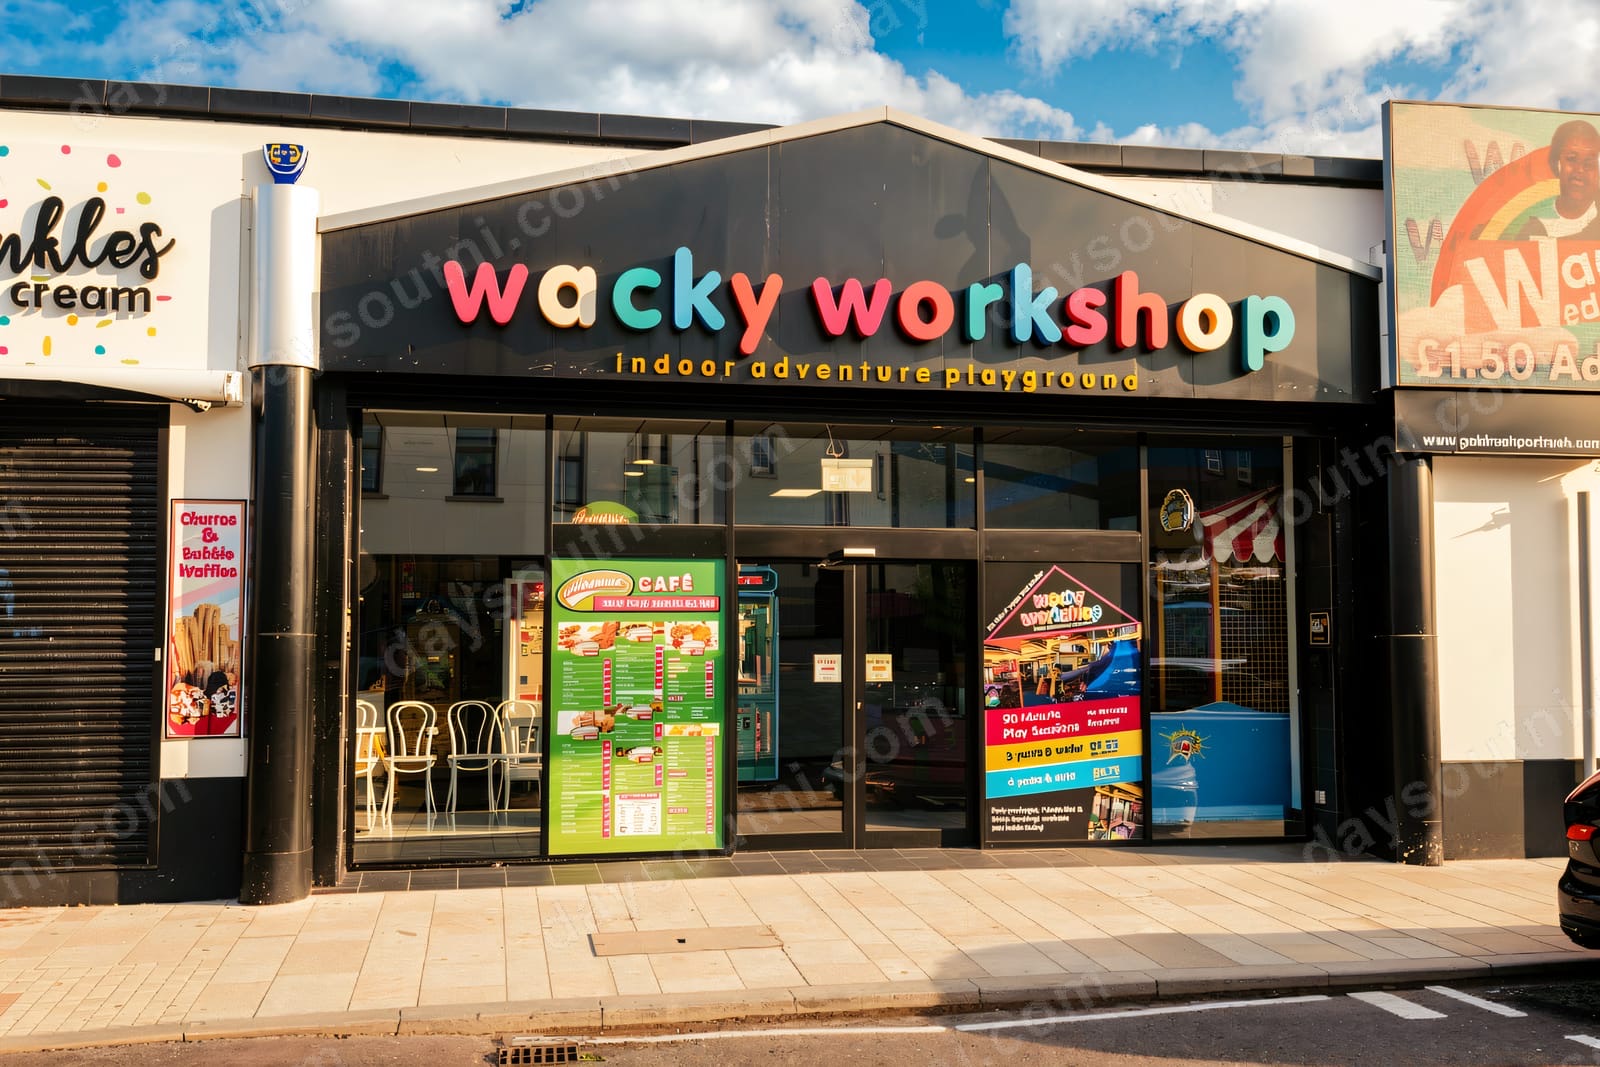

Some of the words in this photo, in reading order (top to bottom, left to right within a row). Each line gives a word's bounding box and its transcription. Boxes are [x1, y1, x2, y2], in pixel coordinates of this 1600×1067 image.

[11, 281, 151, 312] cream
[1464, 236, 1600, 334] Wa
[443, 247, 784, 355] wacky
[812, 262, 1296, 372] workshop
[616, 352, 735, 378] indoor
[751, 358, 931, 384] adventure
[945, 363, 1139, 393] playground
[638, 573, 694, 592] CAFÉ
